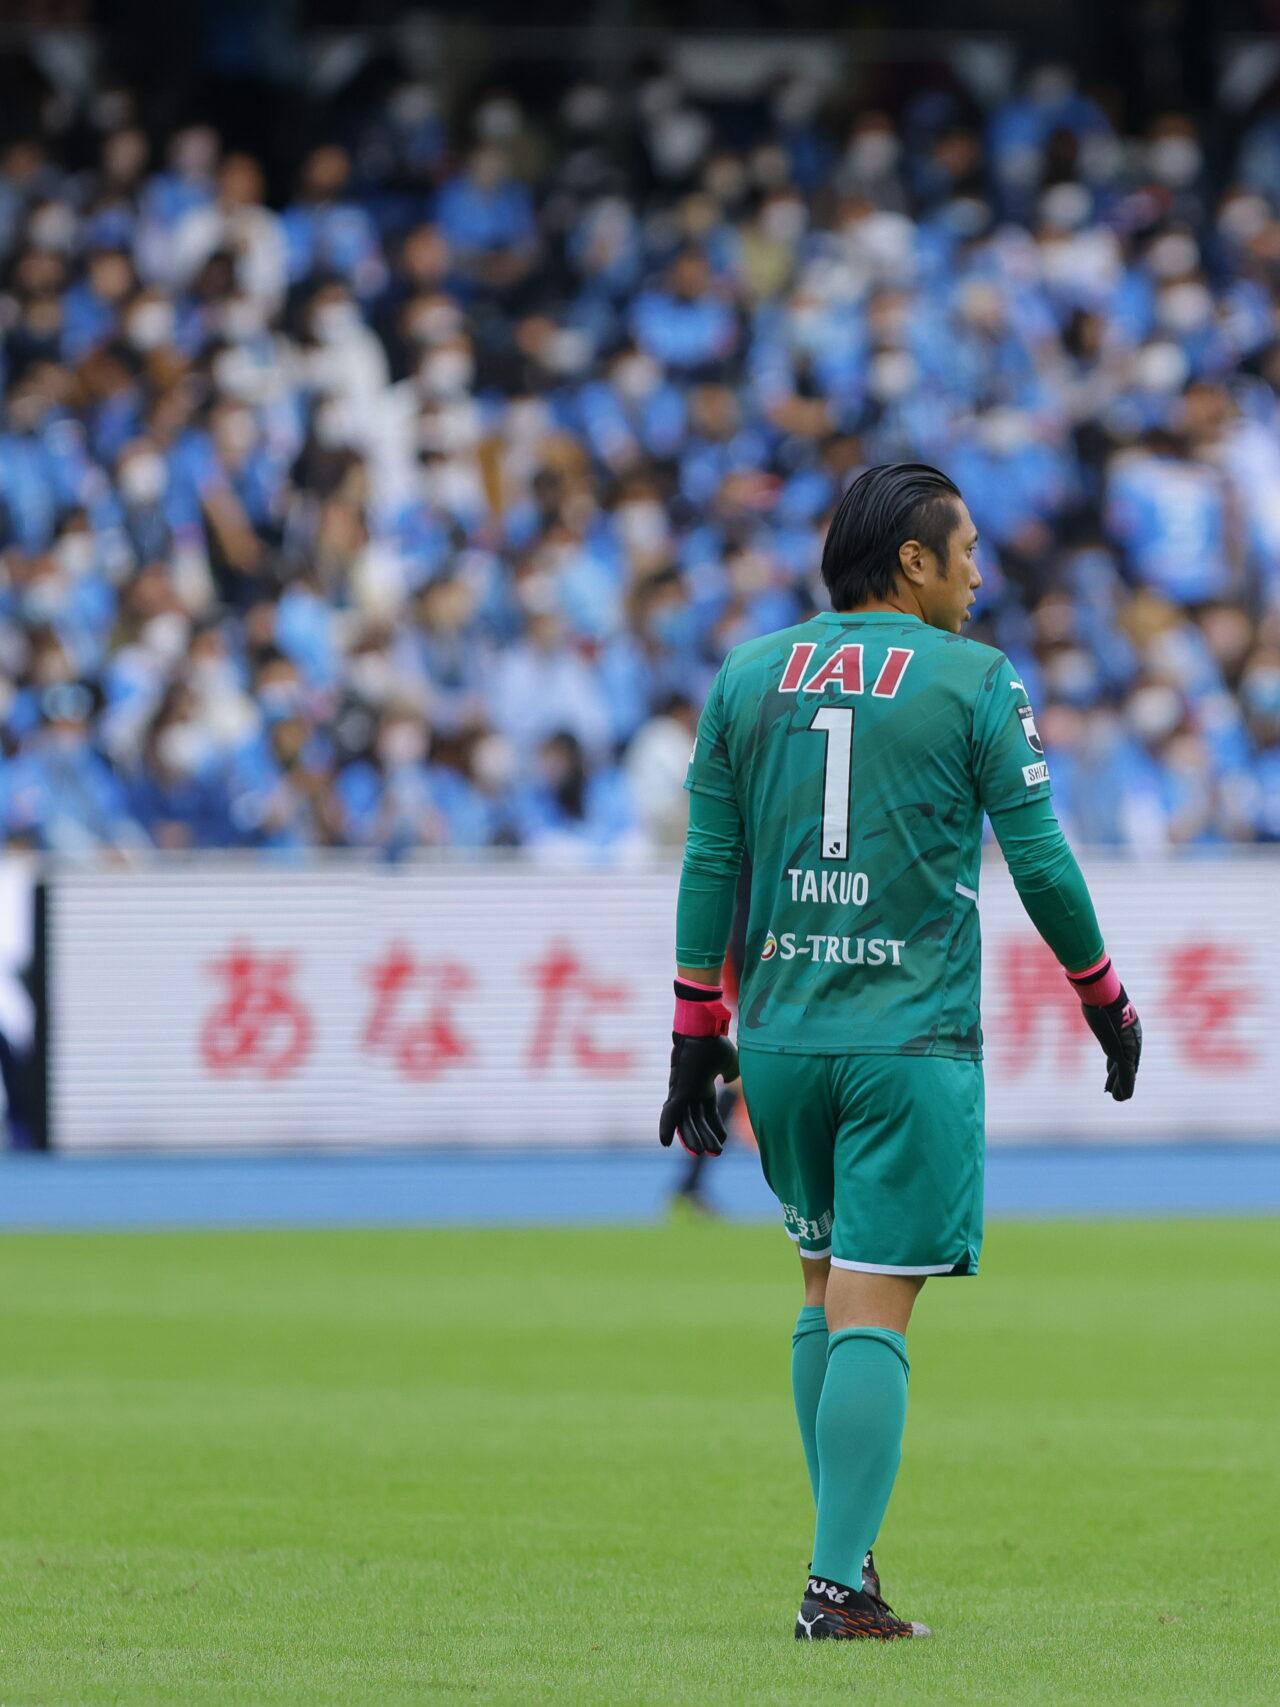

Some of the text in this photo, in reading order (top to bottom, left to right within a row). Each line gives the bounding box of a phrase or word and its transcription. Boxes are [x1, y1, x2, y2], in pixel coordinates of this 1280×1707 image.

[778, 642, 914, 698] IAI
[808, 706, 855, 860] 1
[787, 868, 869, 906] TAKUO
[779, 932, 906, 966] S-TRUST
